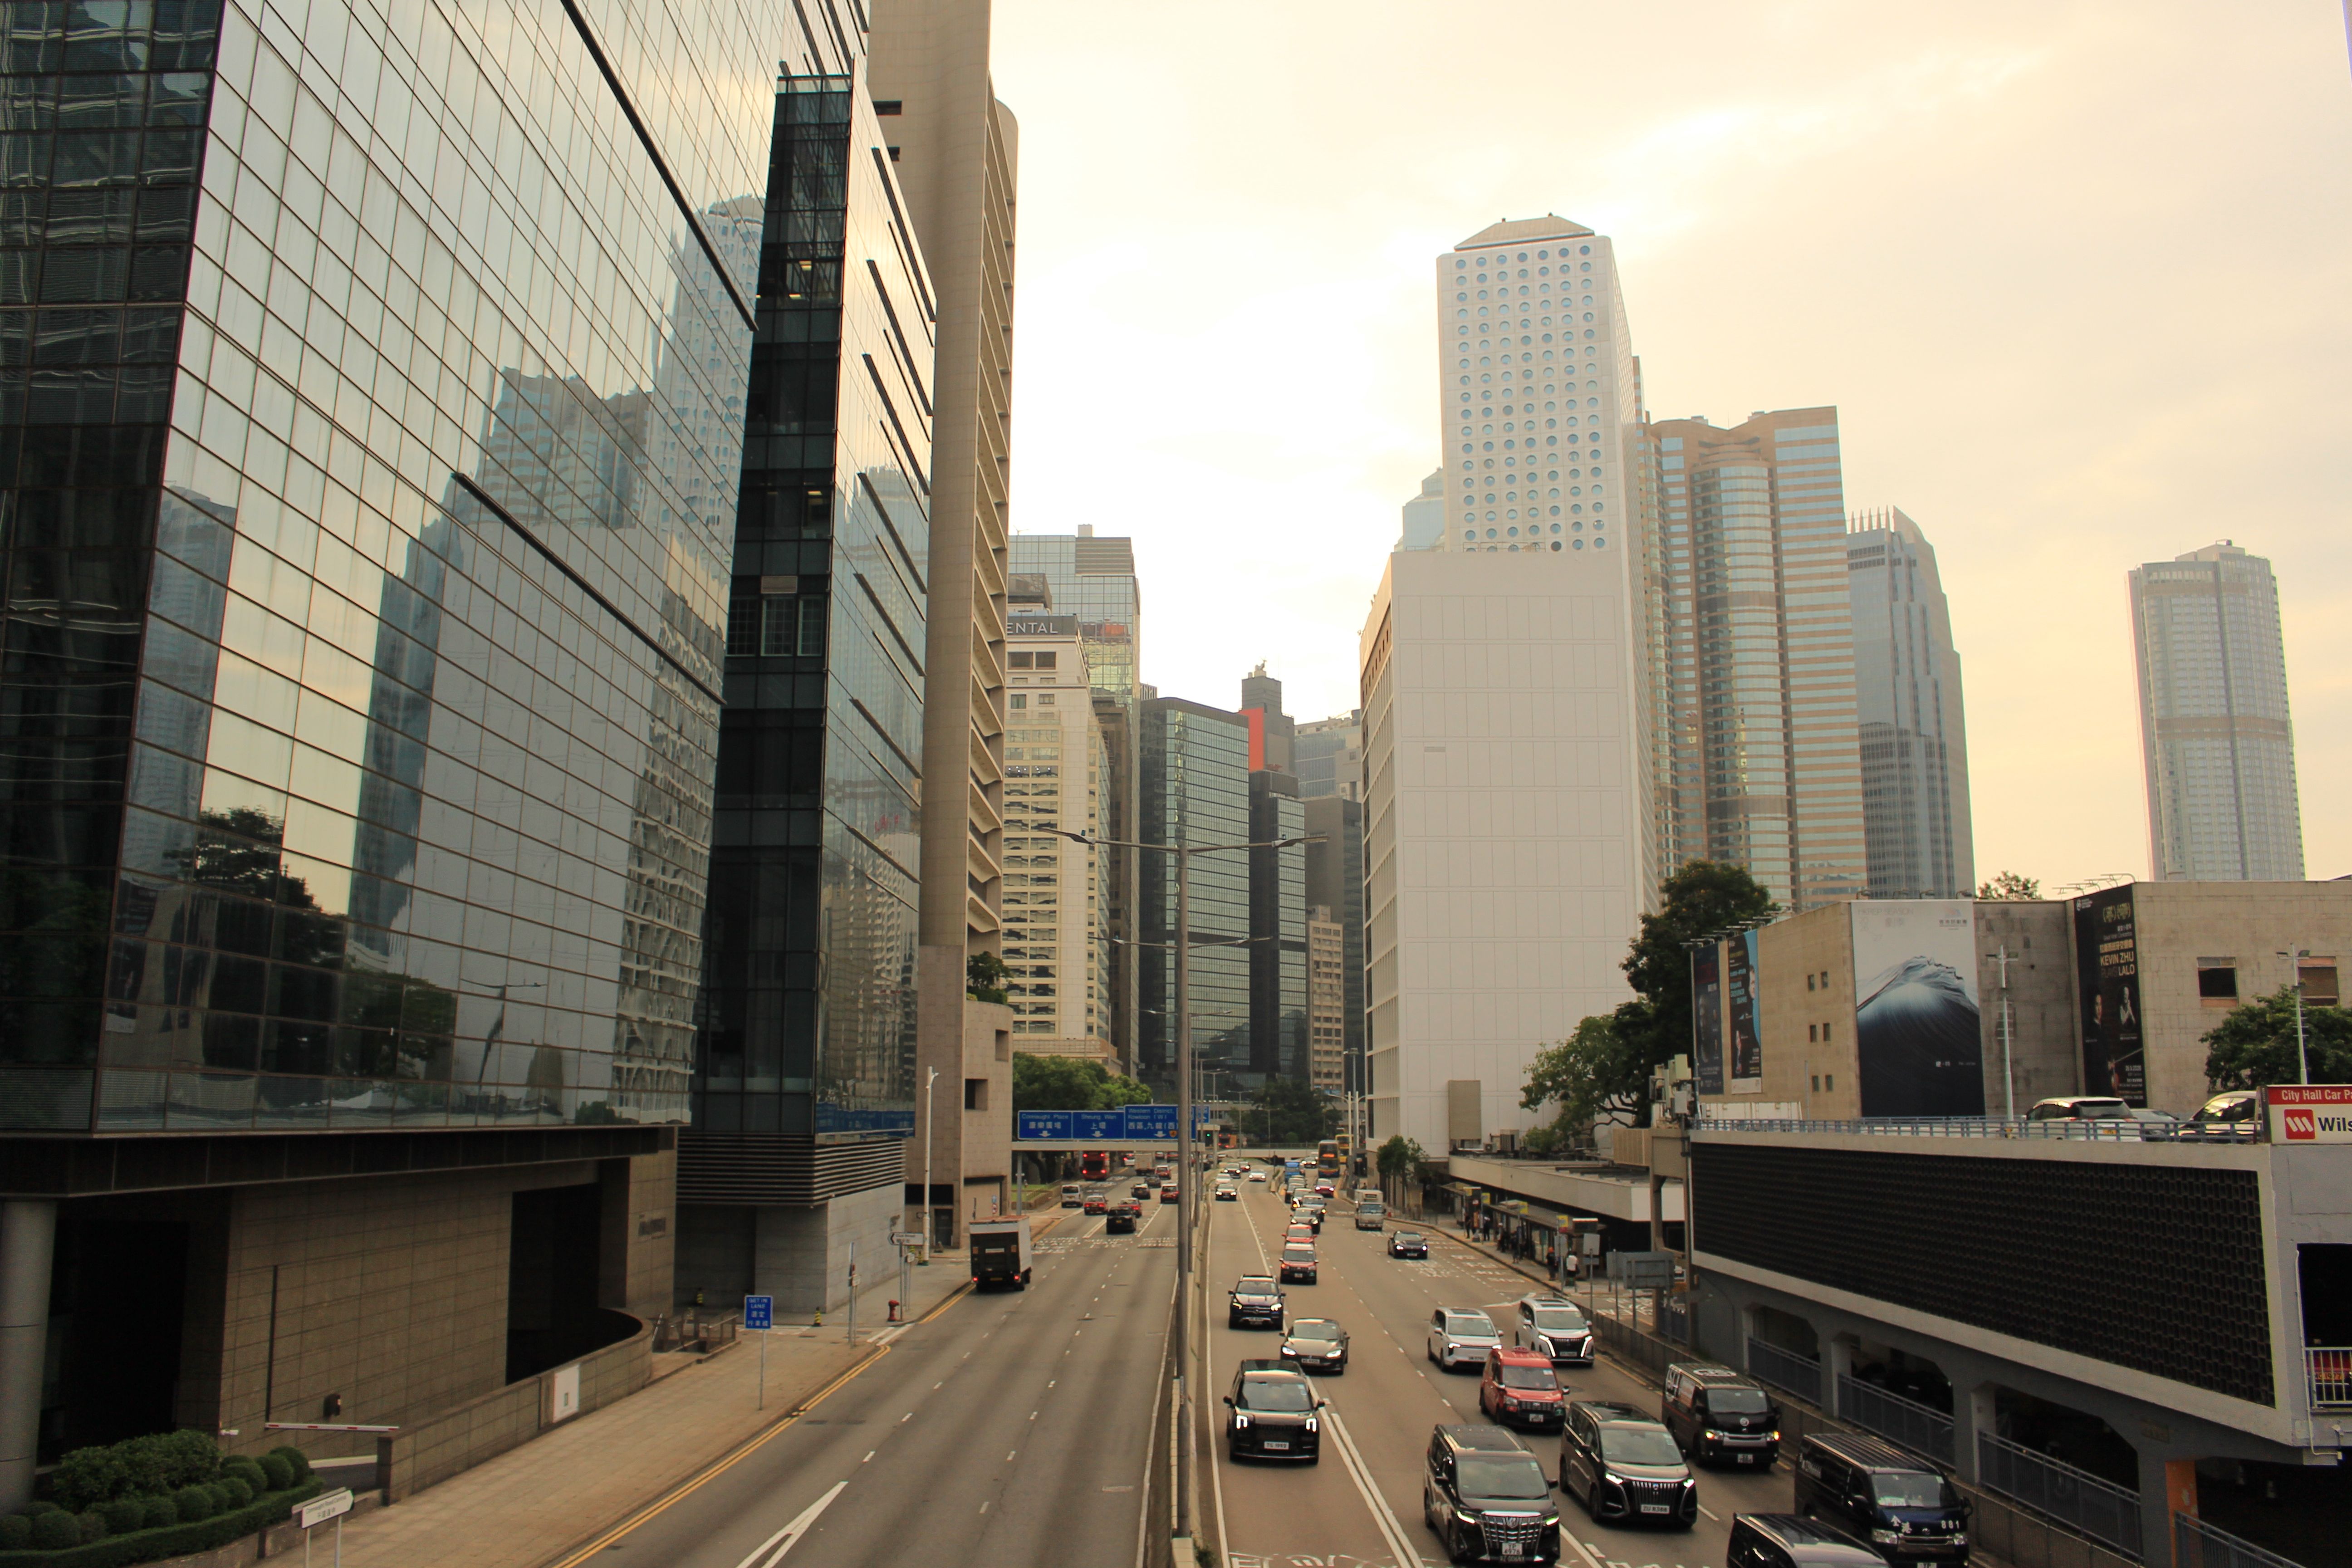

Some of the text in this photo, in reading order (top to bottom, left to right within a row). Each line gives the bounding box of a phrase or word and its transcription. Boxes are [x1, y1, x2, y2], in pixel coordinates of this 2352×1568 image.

[2100, 951, 2134, 966] KEVIN ZHU
[2118, 964, 2135, 976] LALO
[2281, 1090, 2299, 1102] City
[2303, 1090, 2322, 1100] Hall
[2325, 1089, 2341, 1100] Car
[1940, 1520, 1960, 1529] 881
